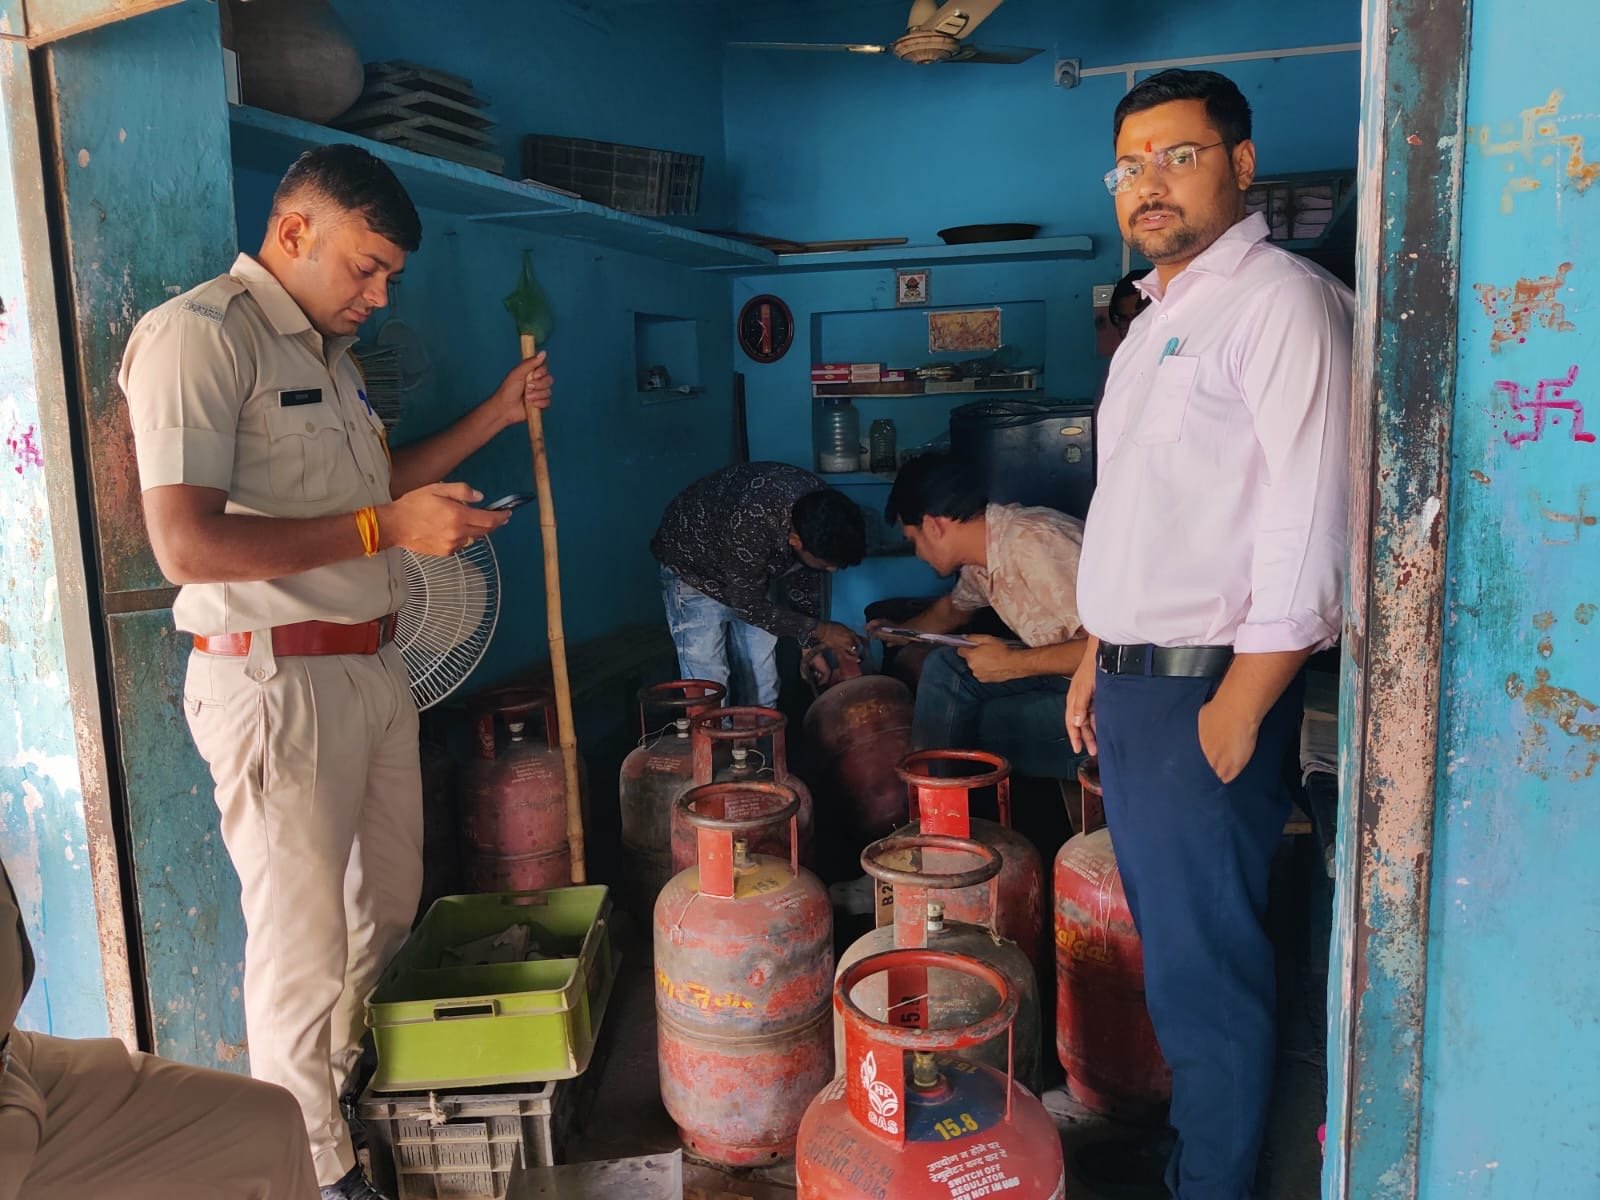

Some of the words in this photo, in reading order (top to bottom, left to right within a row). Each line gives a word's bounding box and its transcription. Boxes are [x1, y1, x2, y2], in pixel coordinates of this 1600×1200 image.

[881, 880, 894, 906] B2
[874, 1085, 893, 1098] HP
[868, 1111, 898, 1134] GAS
[934, 1113, 978, 1141] 15.8
[947, 1168, 984, 1189] SWITCH
[984, 1163, 1002, 1175] OFF
[950, 1172, 1005, 1197] REGULATOR
[970, 1185, 991, 1200] NOT
